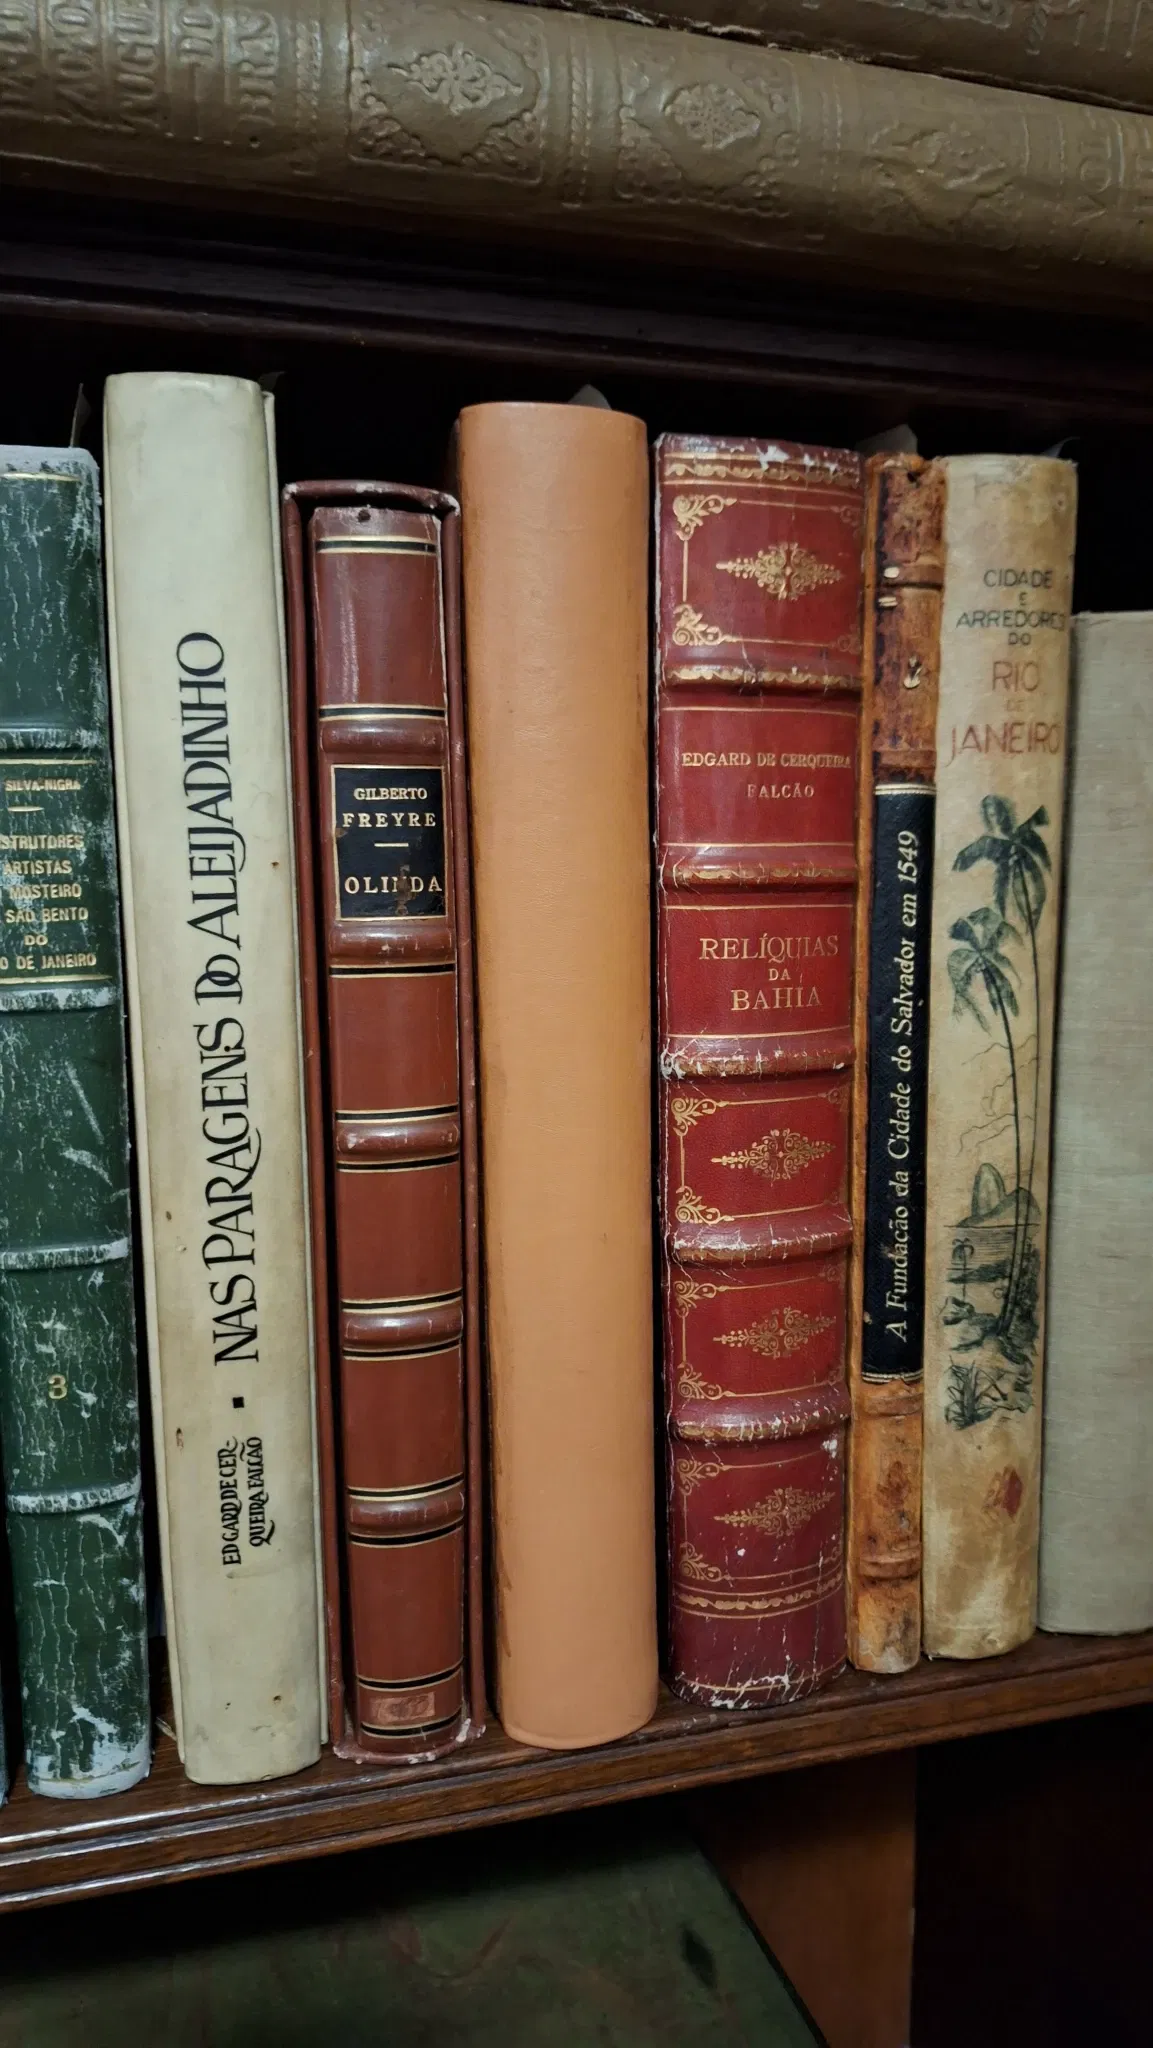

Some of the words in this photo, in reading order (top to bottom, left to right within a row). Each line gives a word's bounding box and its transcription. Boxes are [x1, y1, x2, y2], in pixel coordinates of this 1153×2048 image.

[983, 568, 1054, 589] CIDADE
[1008, 632, 1032, 646] DO
[991, 660, 1041, 692] RIO
[945, 720, 1062, 767] JANEIRO
[681, 753, 751, 767] EDGARD
[757, 754, 775, 767] DE
[780, 754, 852, 770] CERQUEIRA
[353, 788, 428, 801] GILBERTO
[747, 783, 815, 799] FALCÃO
[342, 812, 437, 828] FREYRE
[4, 860, 73, 875] ARTISTAS
[897, 829, 920, 885] 1549
[10, 884, 82, 900] MOSTEIRO
[42, 906, 89, 922] BENTO
[901, 893, 918, 928] em
[23, 934, 49, 946] DO
[699, 933, 840, 964] RELÍQUIAS
[16, 955, 35, 970] DE
[41, 953, 97, 969] JANEIRO
[768, 968, 792, 981] DA
[194, 953, 244, 1006] DO
[890, 937, 916, 1036] Salvador
[731, 986, 823, 1012] BAHIA
[890, 1044, 912, 1072] do
[887, 1081, 912, 1160] Cidade
[193, 1016, 262, 1271] PARAGENS
[888, 1170, 909, 1197] da
[209, 1273, 259, 1367] NAS
[885, 1321, 908, 1343] A
[47, 1374, 68, 1400] 3
[220, 1479, 238, 1500] DE
[248, 1488, 276, 1547] QUEIRA
